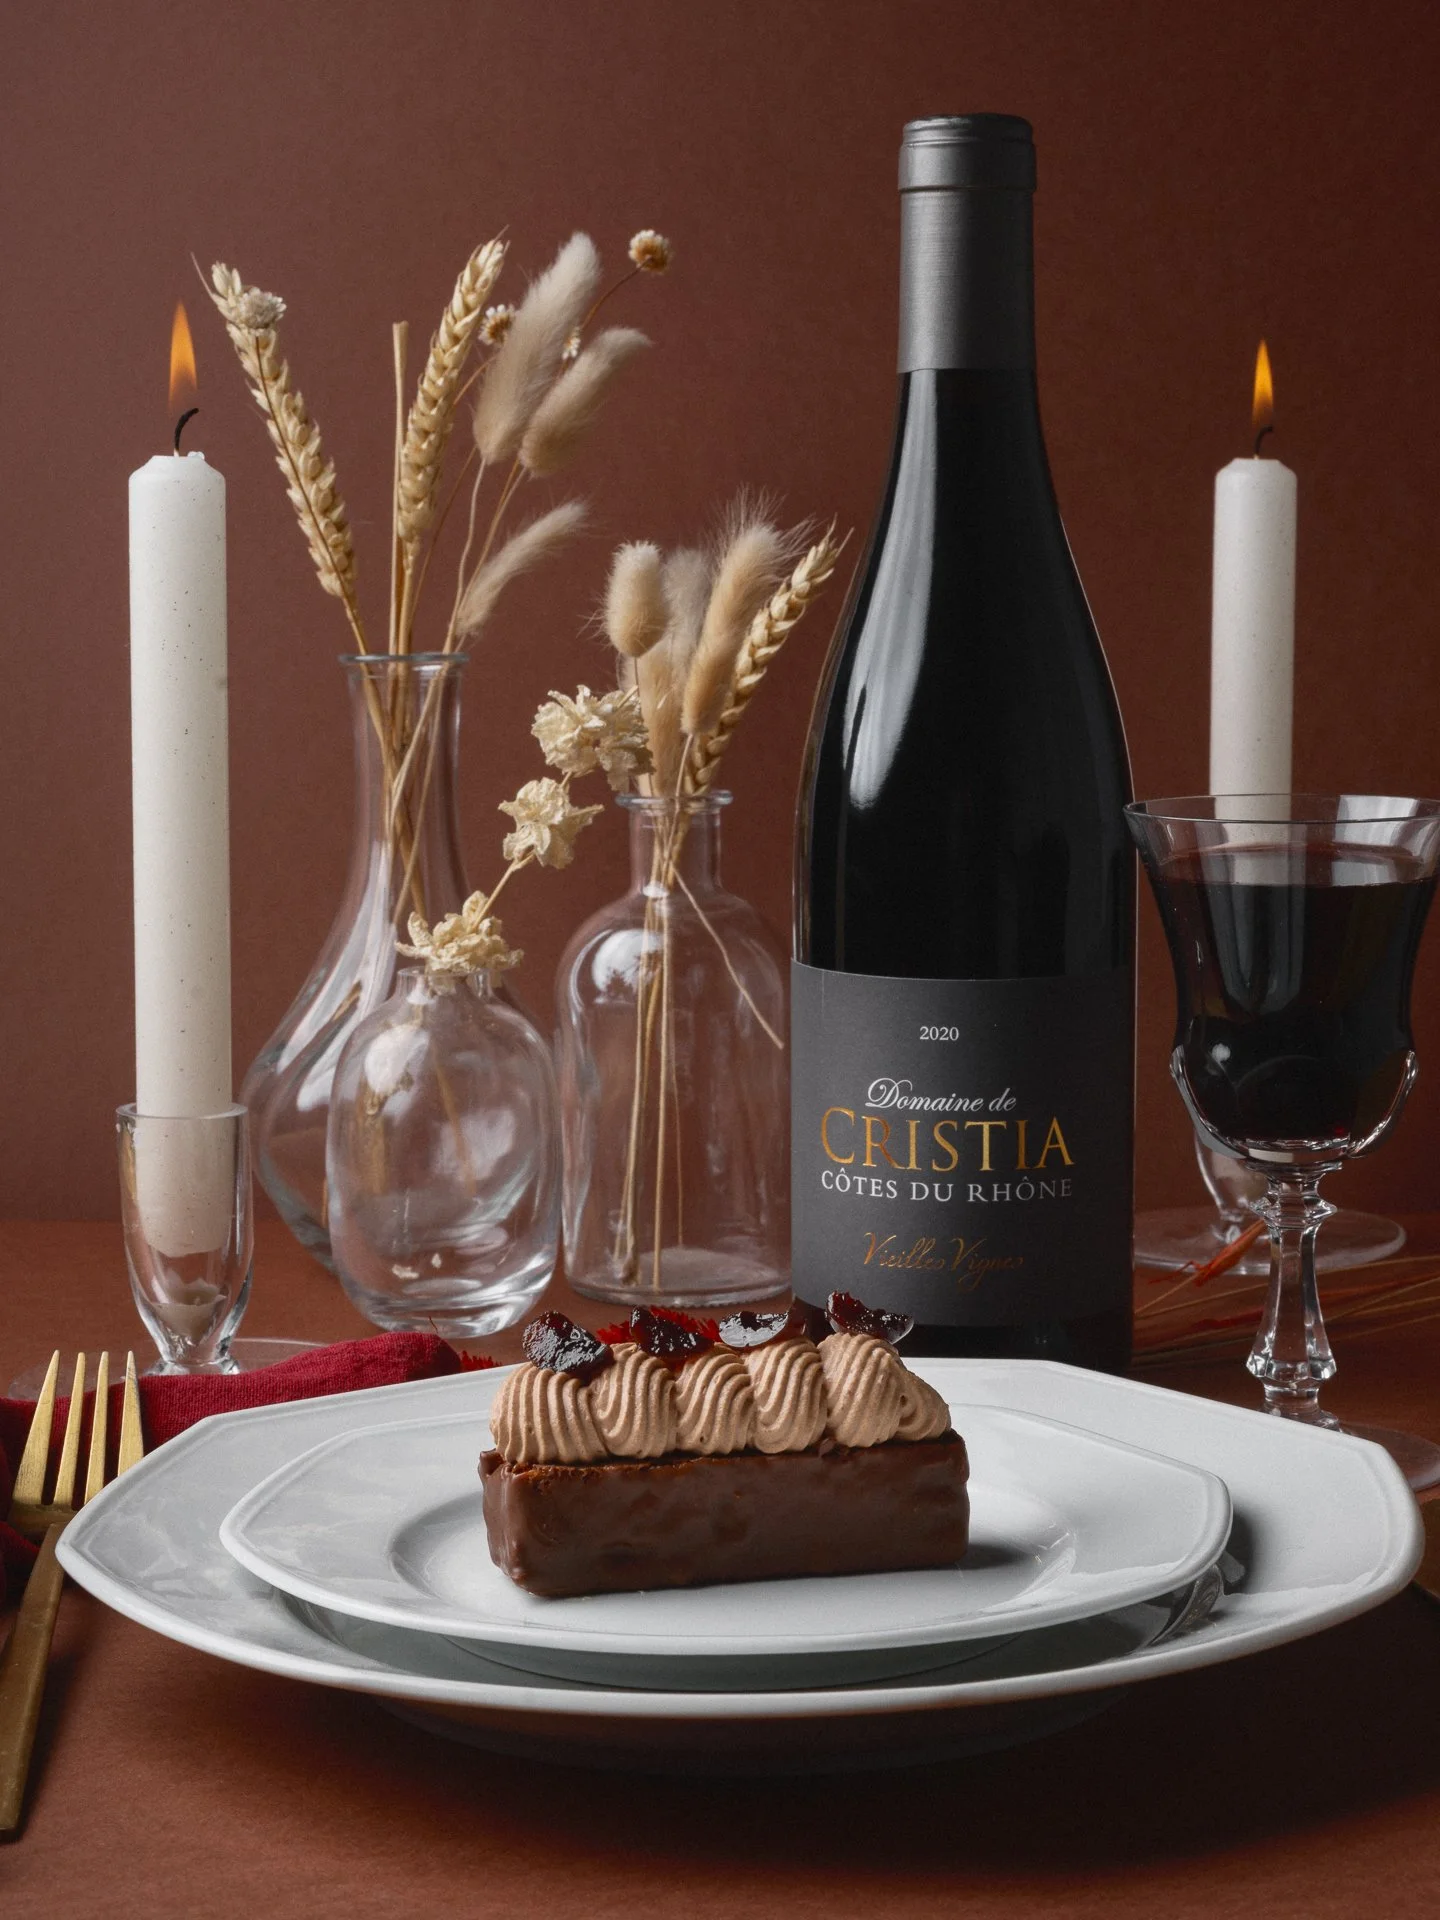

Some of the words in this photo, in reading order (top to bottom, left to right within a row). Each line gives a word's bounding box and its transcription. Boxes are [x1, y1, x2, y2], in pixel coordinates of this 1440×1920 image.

[919, 1025, 960, 1041] 2020
[865, 1077, 984, 1112] Domaine
[988, 1087, 1017, 1112] de
[820, 1106, 1075, 1172] CRISTIA
[821, 1167, 898, 1199] CÔTES
[909, 1181, 955, 1202] DU
[967, 1175, 1073, 1202] RHÔNE
[863, 1231, 944, 1270] Vieilles
